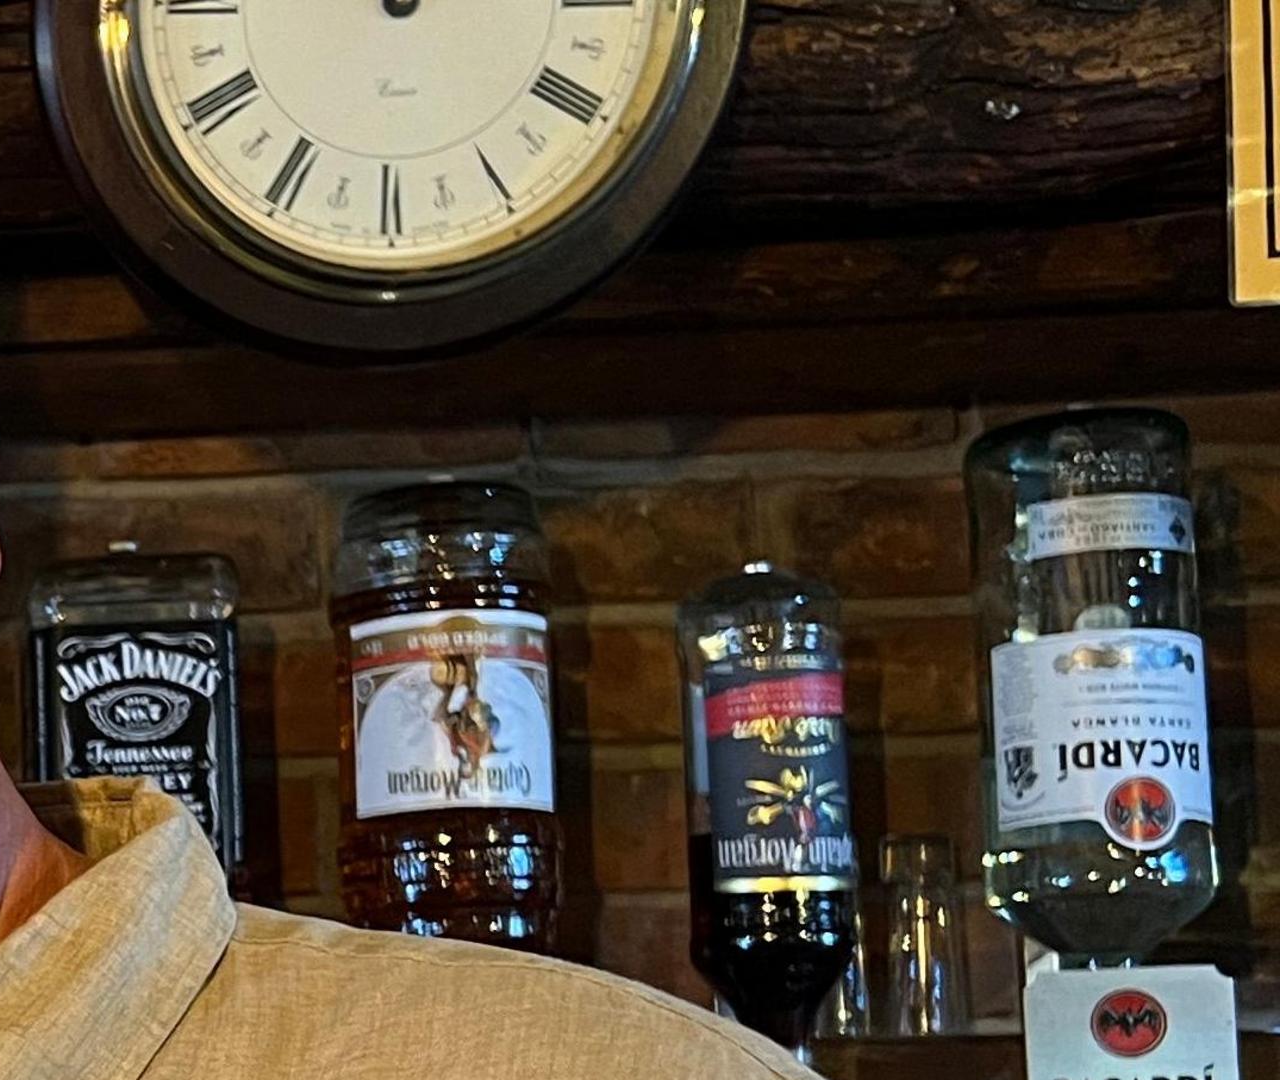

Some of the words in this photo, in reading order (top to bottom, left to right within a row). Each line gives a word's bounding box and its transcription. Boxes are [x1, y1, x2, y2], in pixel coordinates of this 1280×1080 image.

[56, 652, 122, 702] JACK
[121, 640, 223, 698] DANIEL'S
[1070, 715, 1141, 730] BLANCA
[1148, 717, 1191, 731] CARTA
[86, 739, 194, 765] Tennessee
[1057, 739, 1201, 783] BACARDÍ
[386, 766, 466, 799] Morgan
[467, 763, 532, 799] Captain
[717, 833, 803, 872] Morgan
